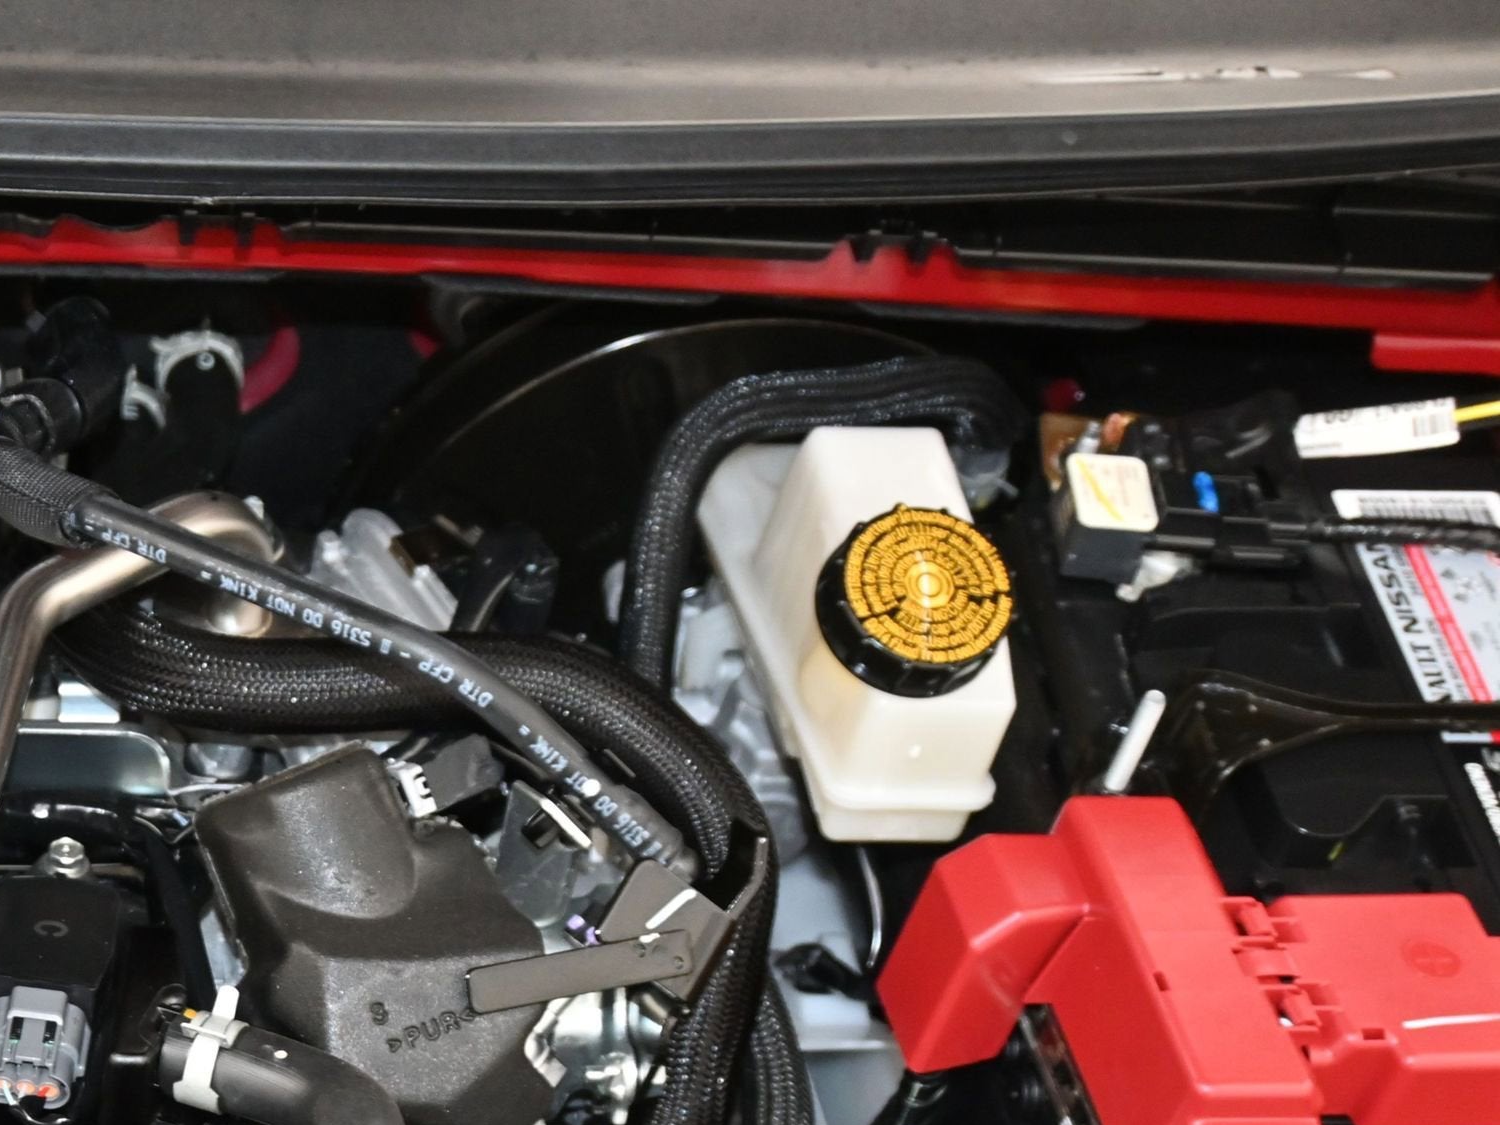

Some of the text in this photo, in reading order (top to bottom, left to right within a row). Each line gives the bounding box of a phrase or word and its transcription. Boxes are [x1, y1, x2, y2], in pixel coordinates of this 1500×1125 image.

[102, 526, 130, 549] CFP
[137, 539, 166, 563] DTR
[220, 574, 258, 601] KINK
[266, 597, 296, 617] NOT
[302, 608, 324, 628] DO
[418, 656, 455, 684] CFP
[457, 678, 494, 708] DTR
[530, 736, 569, 772] KINK
[565, 772, 592, 797] OT
[594, 796, 618, 817] DO
